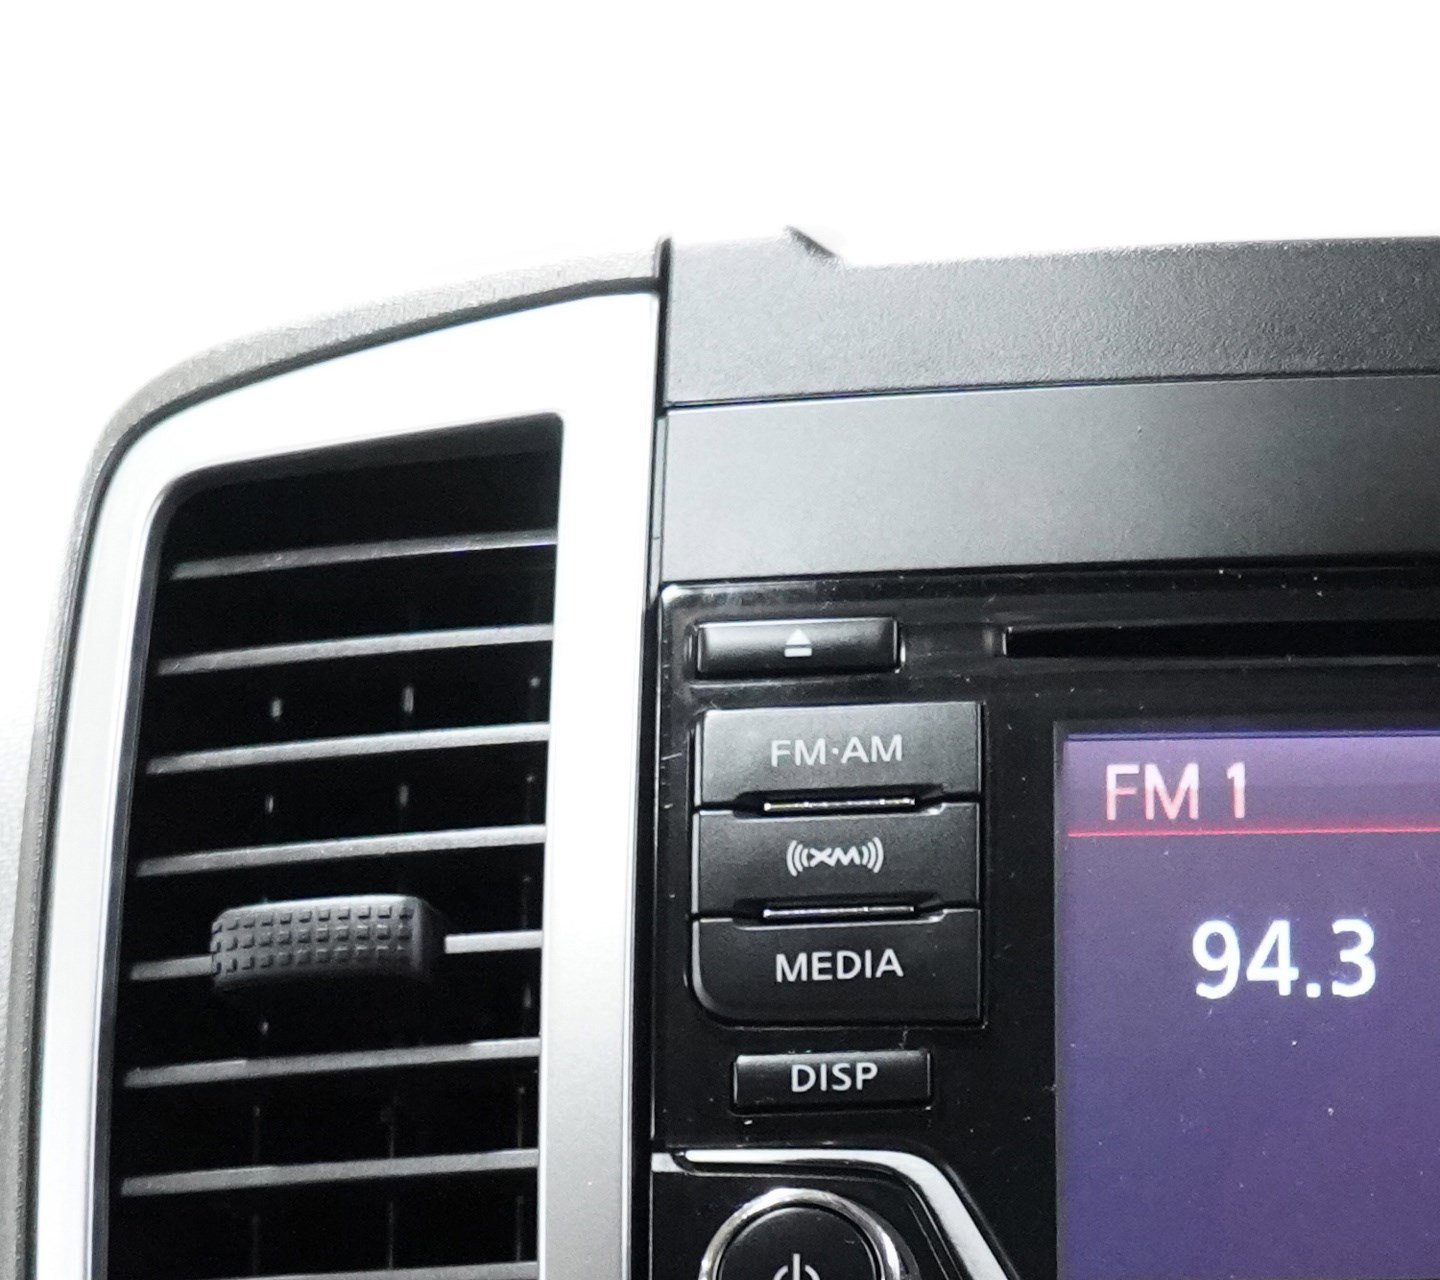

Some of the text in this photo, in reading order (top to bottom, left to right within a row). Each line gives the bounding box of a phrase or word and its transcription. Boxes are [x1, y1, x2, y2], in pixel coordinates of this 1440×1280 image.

[1104, 760, 1248, 822] FM 1
[775, 948, 904, 983] MEDIA
[1192, 917, 1377, 1000] 94.3
[790, 1063, 879, 1093] DISP
